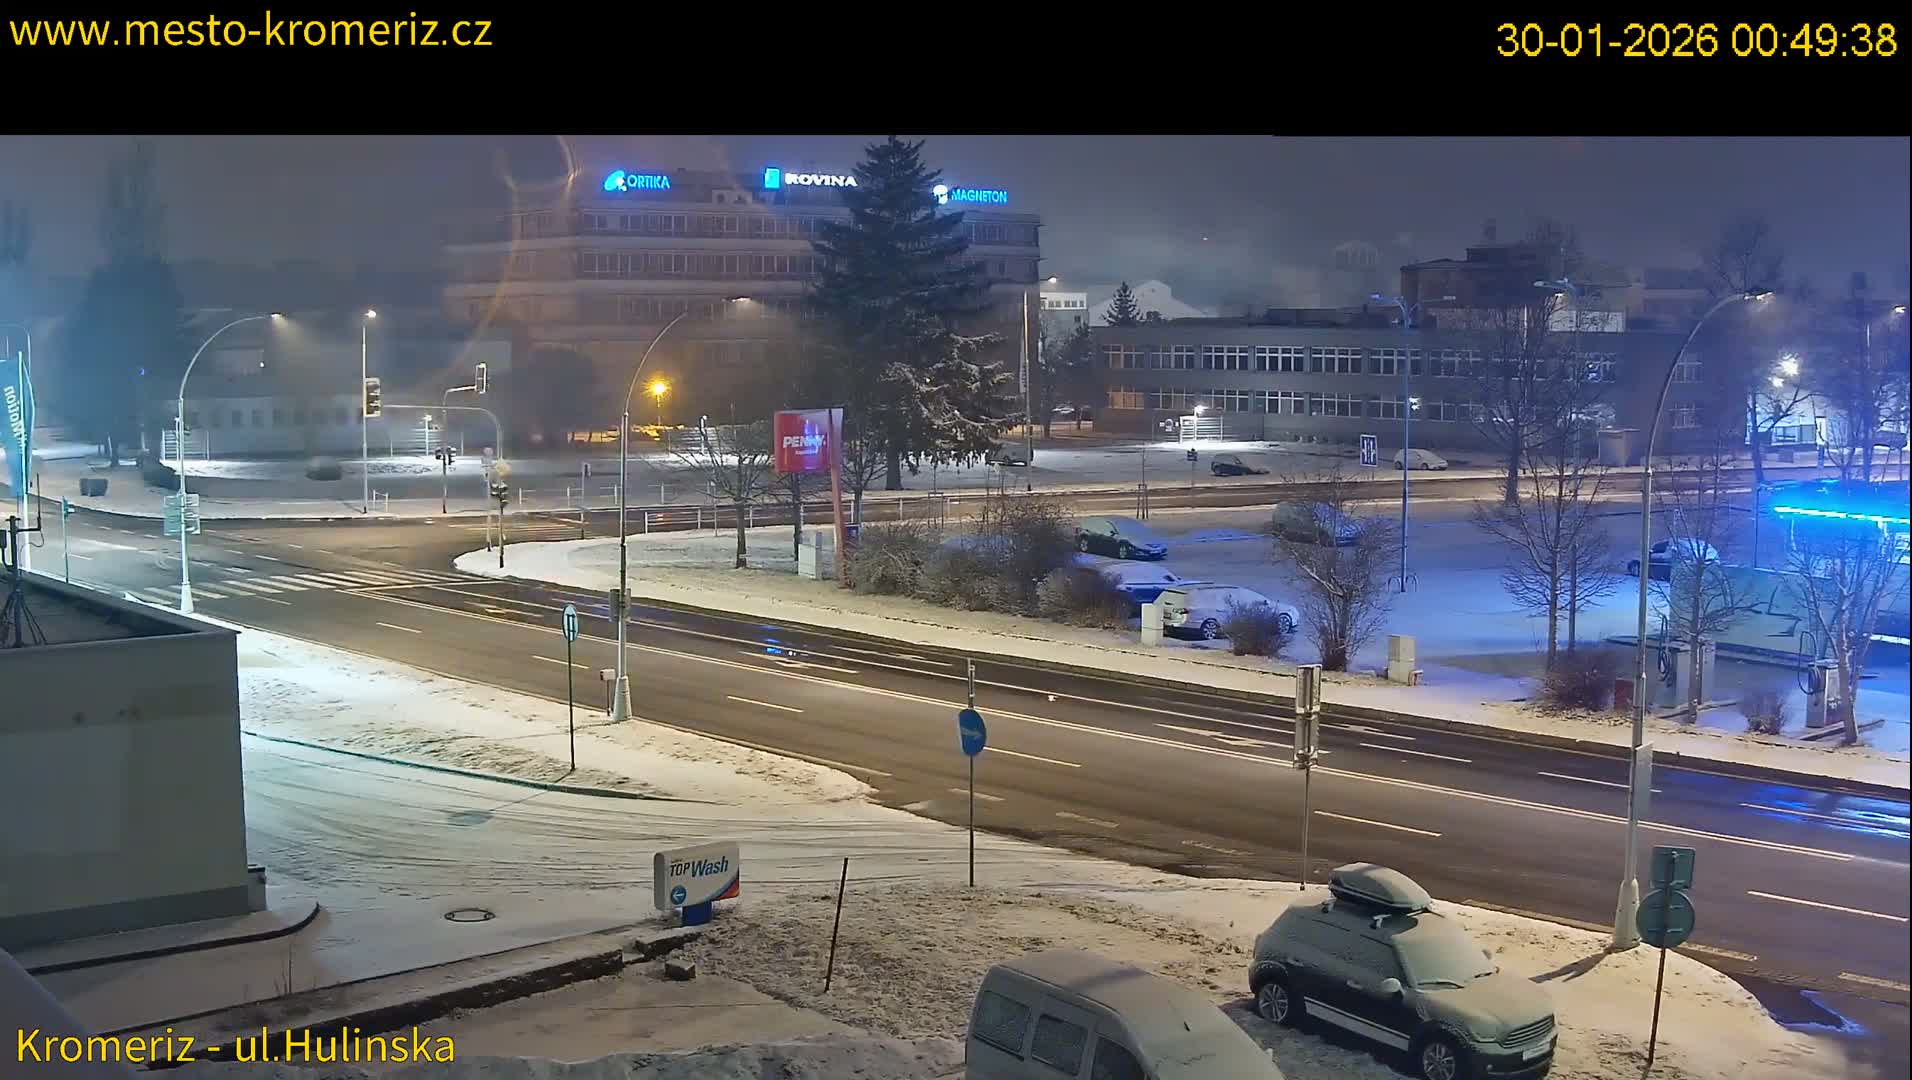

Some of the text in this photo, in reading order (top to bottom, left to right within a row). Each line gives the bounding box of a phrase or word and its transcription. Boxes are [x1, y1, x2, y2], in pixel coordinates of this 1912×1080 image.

[627, 174, 671, 189] ORTIKA
[784, 172, 858, 187] ROVINA
[951, 188, 1008, 203] MAGNETON
